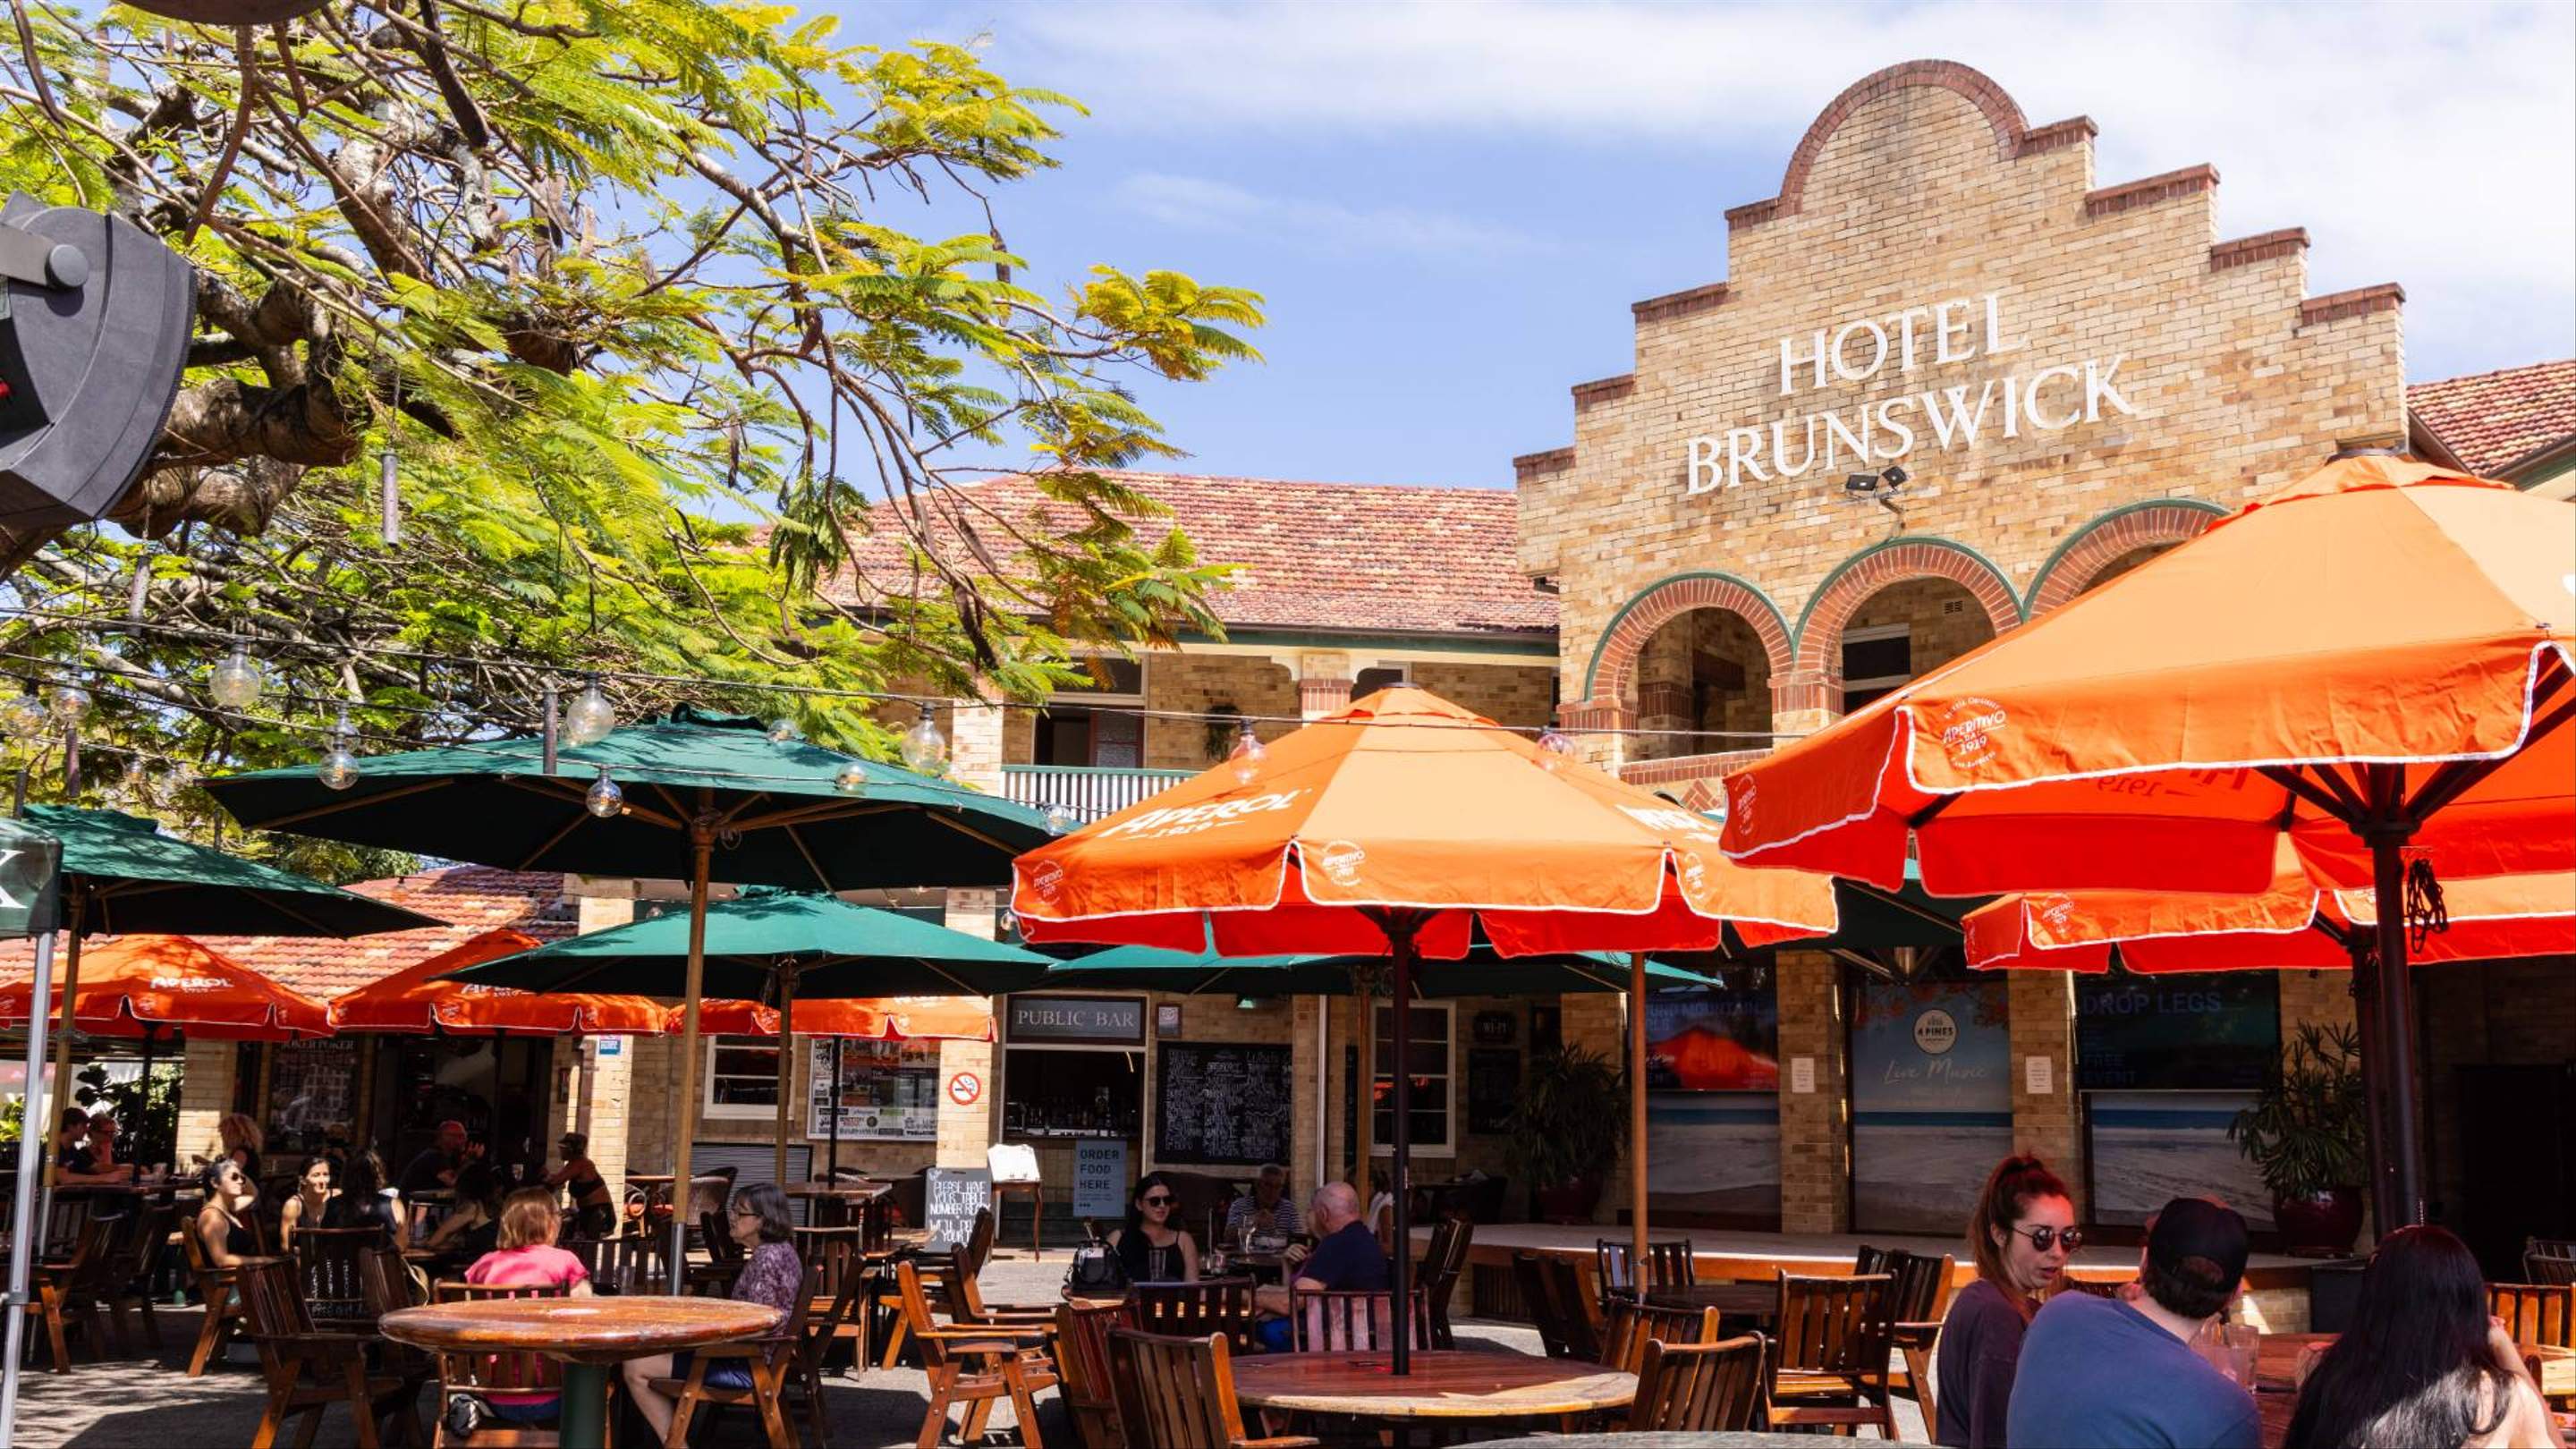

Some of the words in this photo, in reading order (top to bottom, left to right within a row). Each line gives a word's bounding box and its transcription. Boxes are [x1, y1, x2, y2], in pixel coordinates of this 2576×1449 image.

[1779, 294, 2029, 397] HOTEL
[1686, 354, 2144, 495] BRUNSWICK
[1943, 710, 2006, 744] APERITIVO
[1960, 735, 1988, 755] 1919
[1097, 788, 1301, 838] APEROL
[149, 975, 235, 989] APEROL
[2082, 992, 2150, 1015] DROP
[2157, 991, 2223, 1013] LEGS
[1017, 1010, 1086, 1026] PUBLIC
[1096, 1012, 1134, 1027] BAR
[1926, 1026, 1954, 1037] PINES
[1080, 1148, 1120, 1160] ORDER
[1080, 1164, 1112, 1174] FOOD
[1079, 1180, 1112, 1190] HERE
